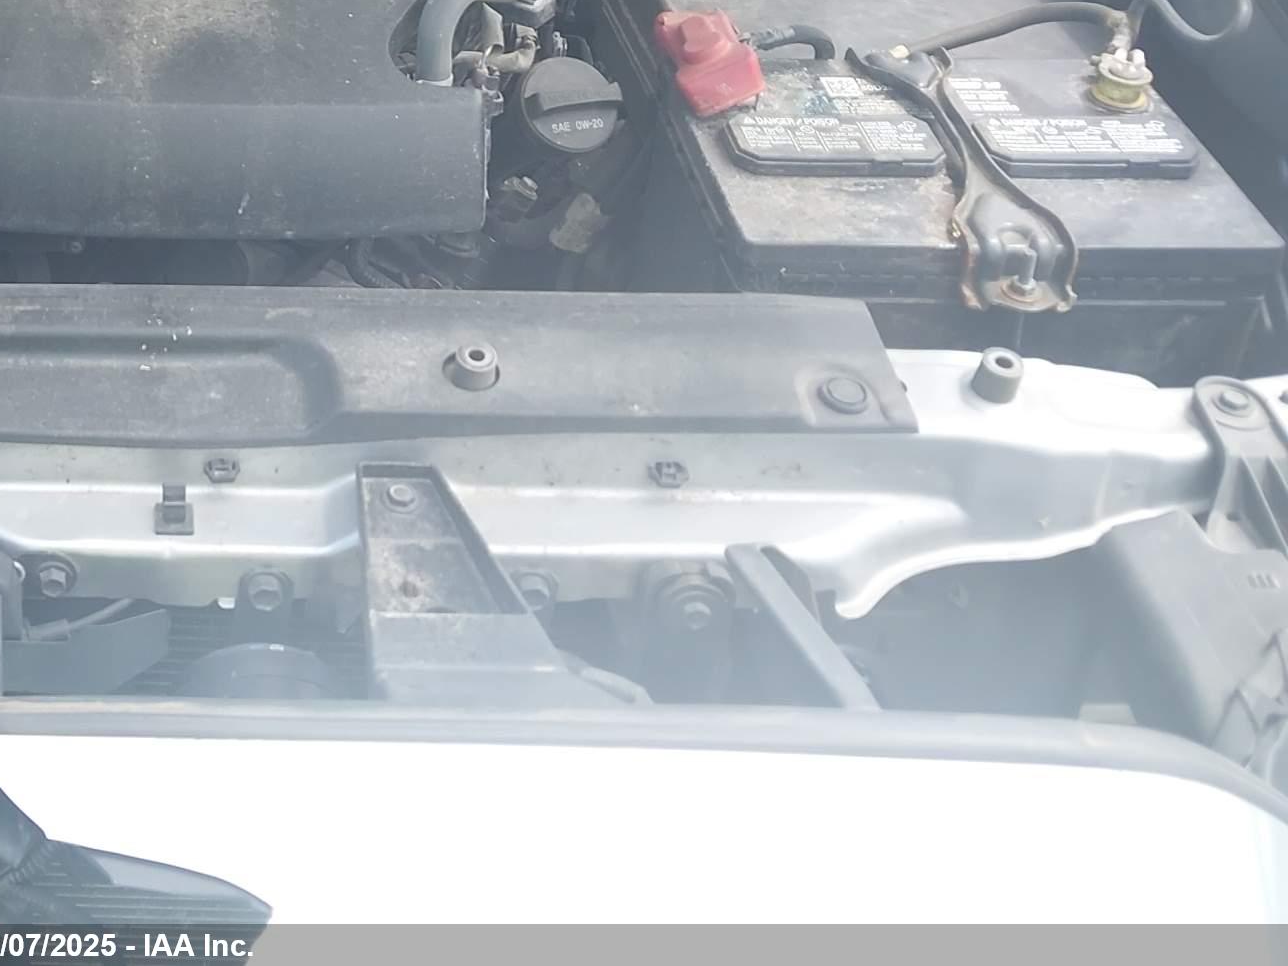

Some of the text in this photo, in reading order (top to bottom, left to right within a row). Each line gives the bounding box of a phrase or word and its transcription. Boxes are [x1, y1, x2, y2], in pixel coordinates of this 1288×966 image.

[552, 118, 604, 134] SAE 0W-20
[754, 116, 794, 126] DANGER
